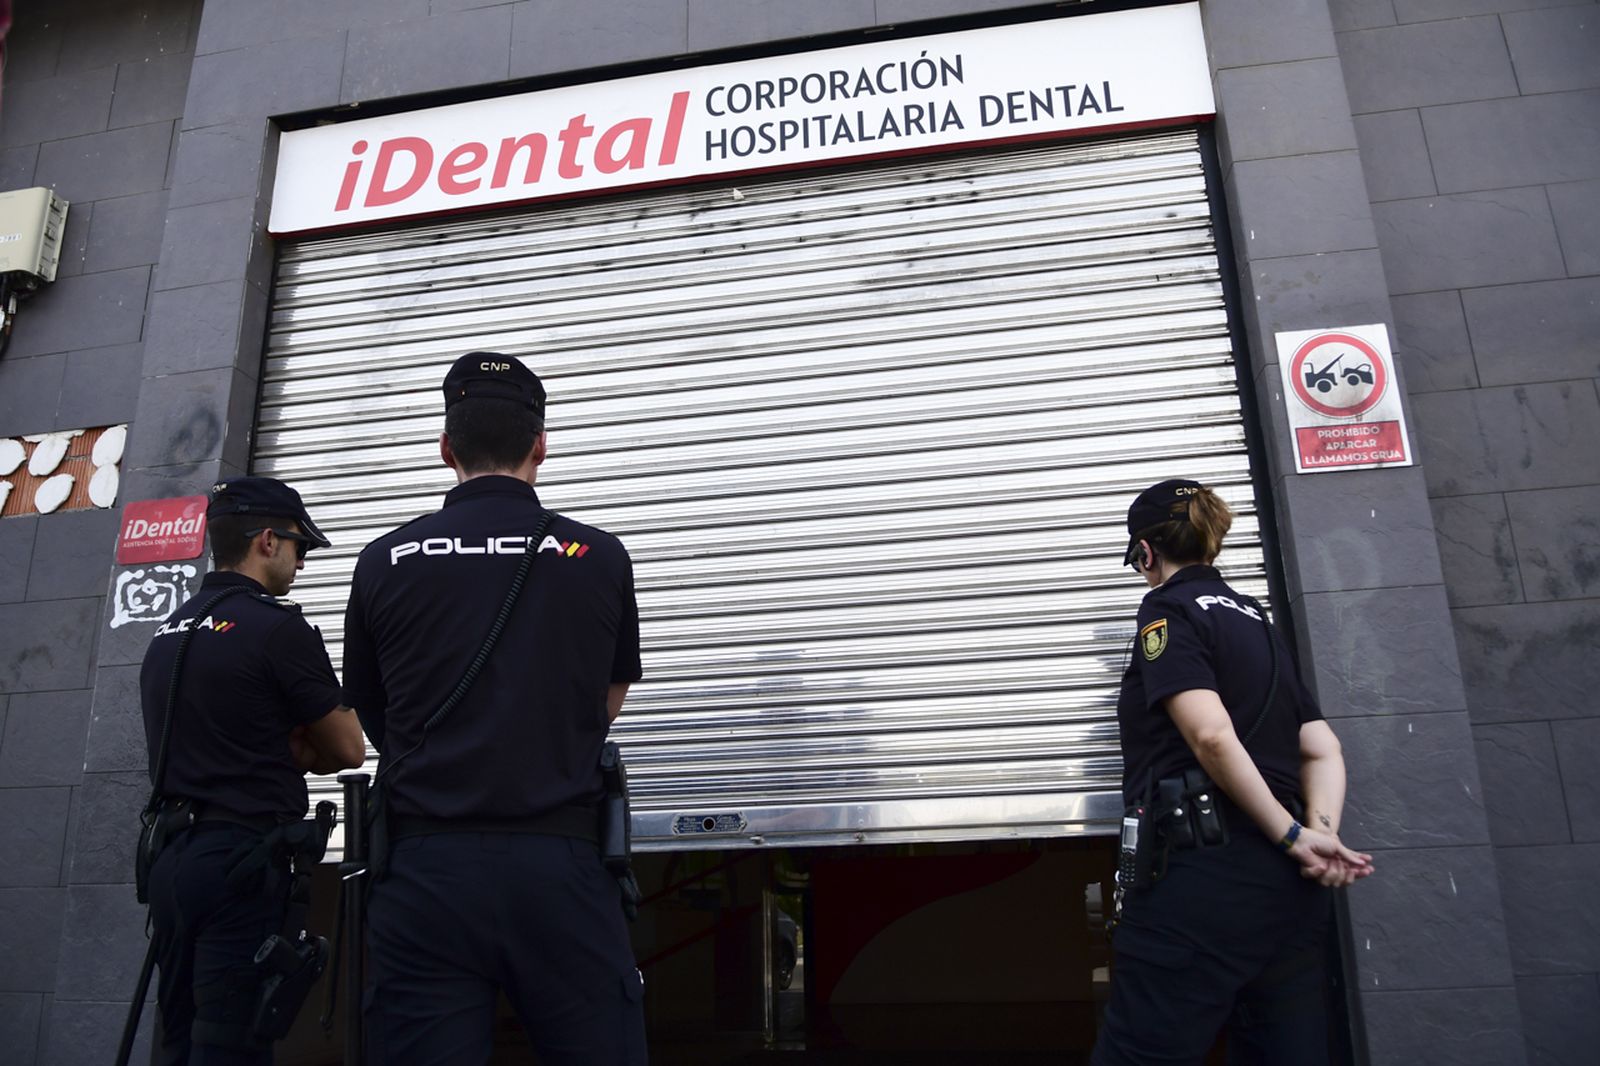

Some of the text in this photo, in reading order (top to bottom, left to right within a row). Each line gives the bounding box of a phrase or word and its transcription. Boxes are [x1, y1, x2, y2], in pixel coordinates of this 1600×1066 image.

[705, 50, 965, 117] CORPORACIÓN
[705, 80, 1125, 161] HOSPITALARIA DENTAL
[334, 91, 691, 212] iDental
[480, 362, 511, 372] CNP
[1317, 426, 1380, 438] PROHIBIDO
[1326, 439, 1377, 451] APARCAR
[1305, 450, 1402, 465] LLAMAMOS GRUA
[124, 512, 205, 540] iDental
[1195, 595, 1262, 621] POLIC
